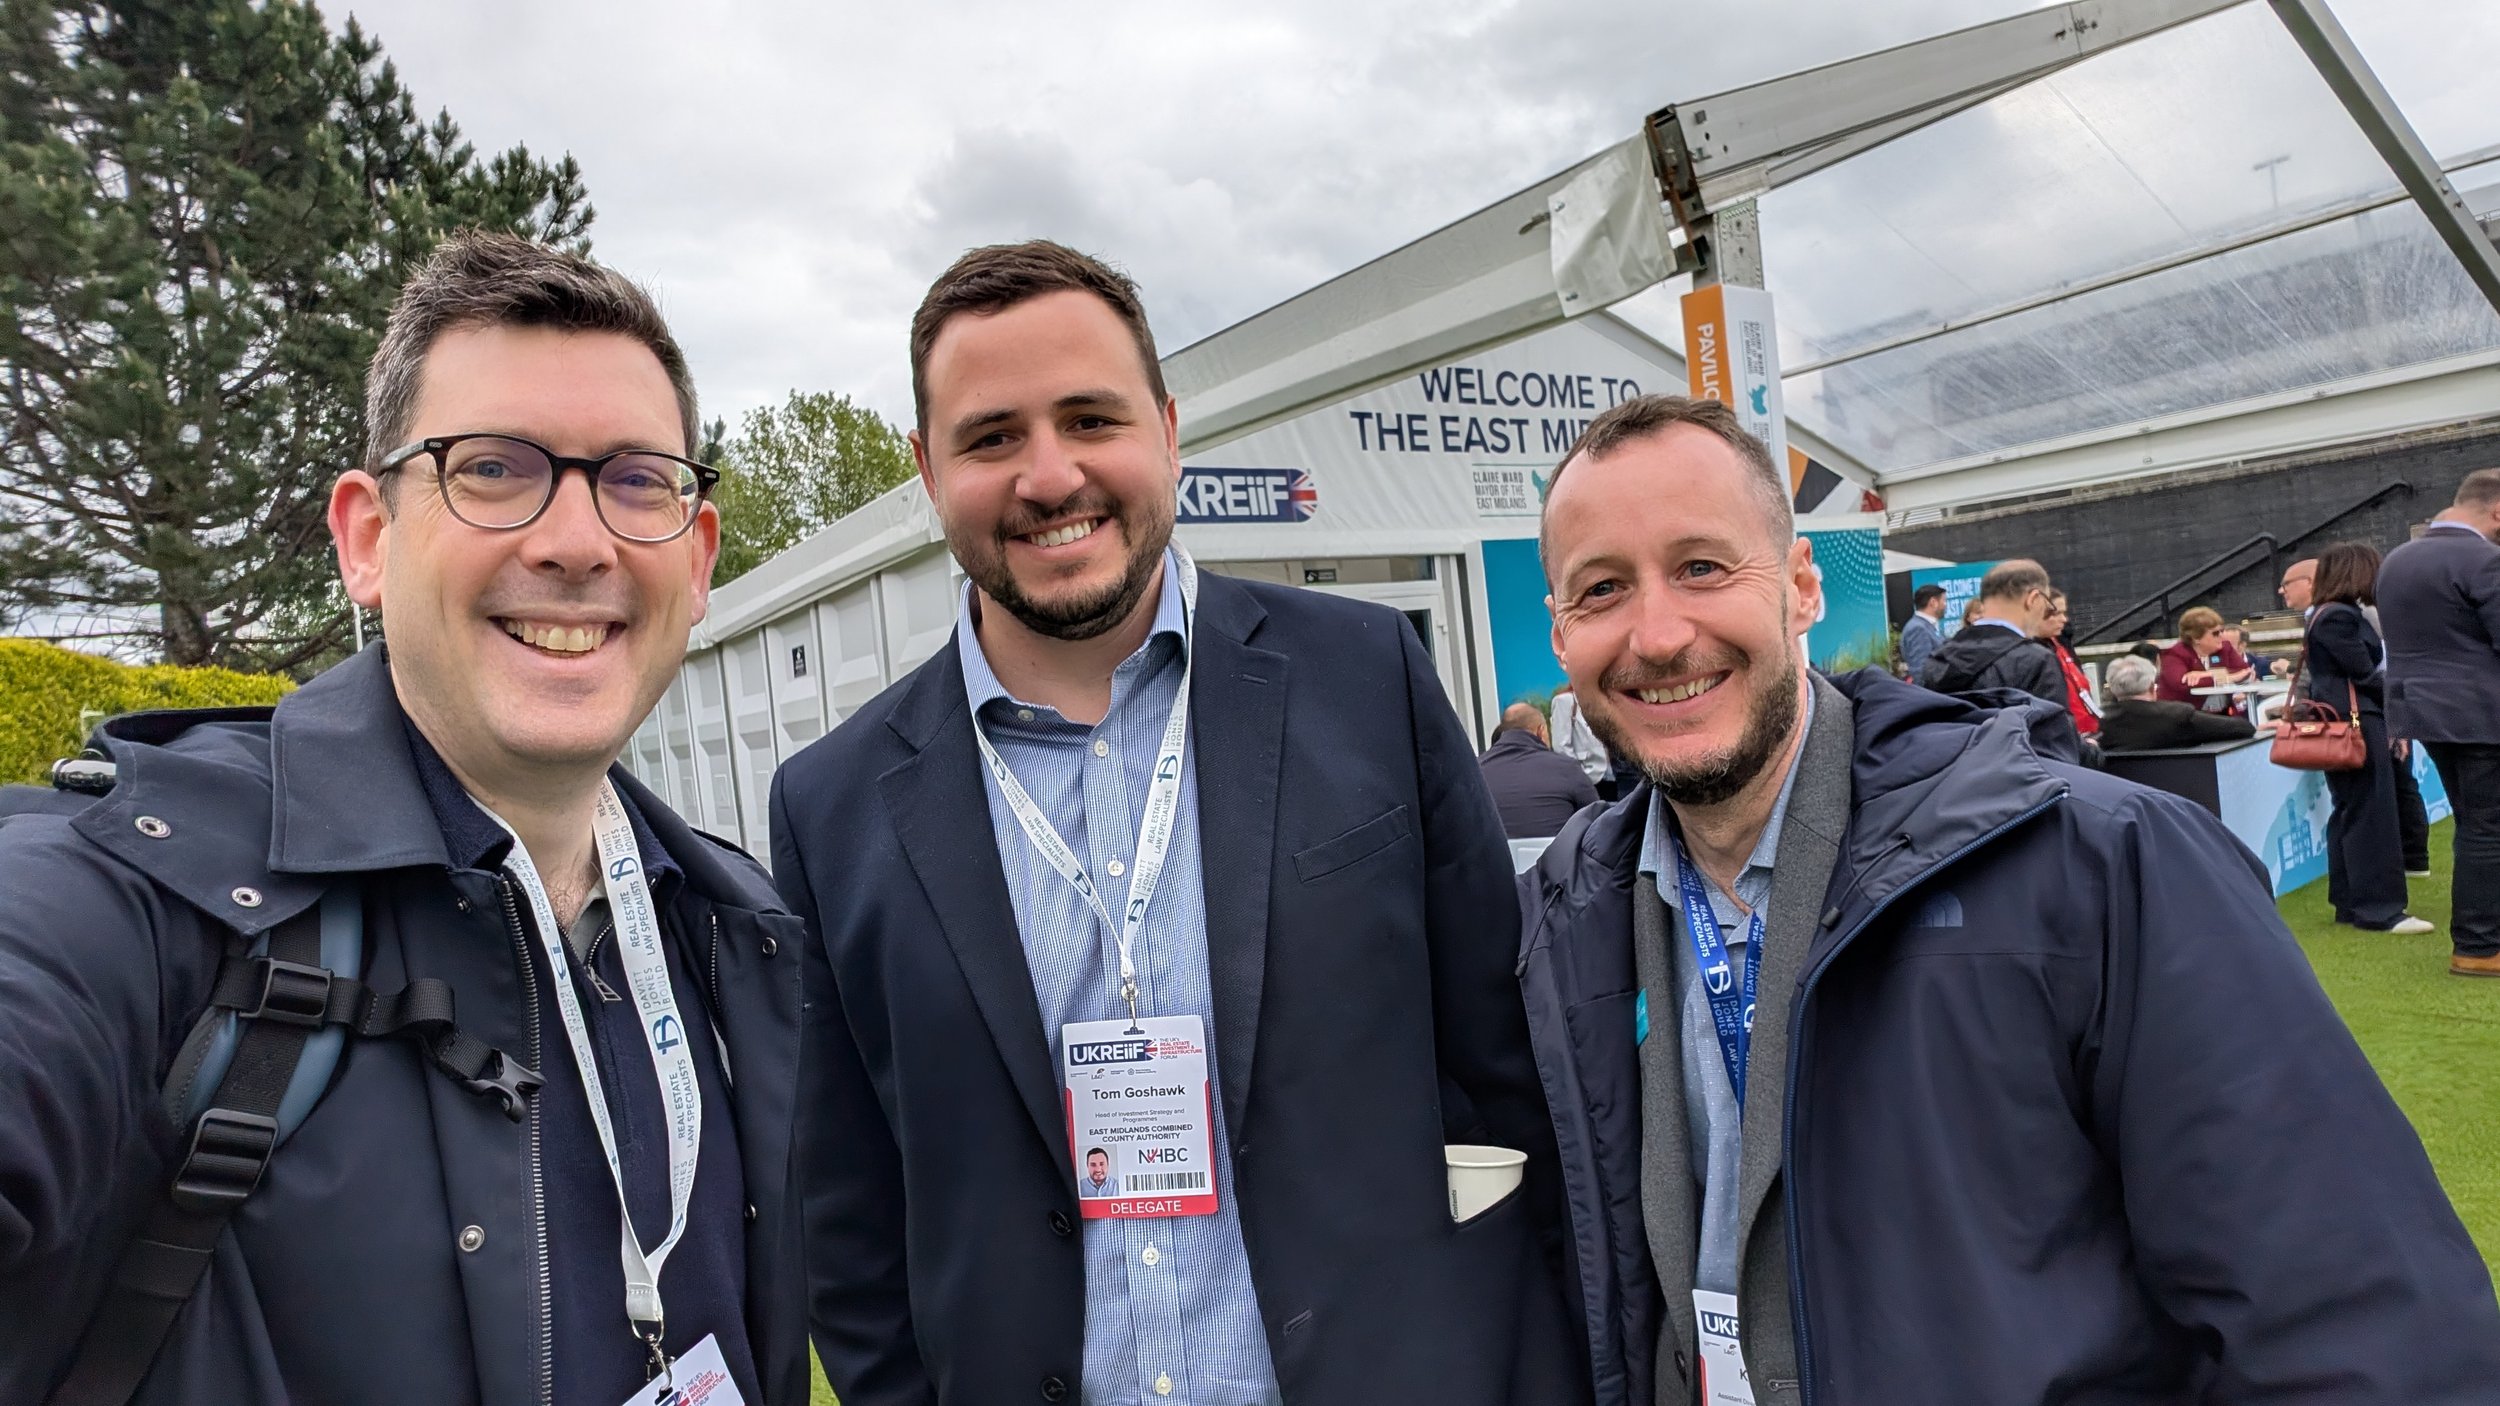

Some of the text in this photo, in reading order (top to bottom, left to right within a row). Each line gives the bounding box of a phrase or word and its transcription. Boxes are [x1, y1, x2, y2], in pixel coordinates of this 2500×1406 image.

[1420, 367, 1596, 409] WELCOME
[1350, 411, 1430, 452] THE
[1440, 415, 1530, 454] EAST
[1473, 471, 1524, 483] CLAIRE WARD
[1475, 484, 1524, 496] MAYOR OF THE
[1477, 497, 1493, 509] EAST
[1176, 715, 1184, 747] BOULD
[607, 804, 620, 820] LAW
[1005, 789, 1022, 813] BOULD
[1008, 785, 1025, 809] JONES
[1034, 817, 1065, 855] REAL ESTATE
[1147, 797, 1163, 844] REAL ESTATE
[1155, 790, 1172, 854] LAW SPECIALISTS
[602, 833, 614, 857] DAVITT
[611, 829, 625, 852] JONES
[1025, 815, 1067, 869] LAW SPECIALISTS
[521, 859, 551, 921] REAL ESTATE
[1135, 859, 1146, 889] DAVITT
[1141, 860, 1154, 891] JONES
[1147, 863, 1160, 892] BOULD
[507, 857, 551, 933] AW SPECIALISTS
[620, 891, 641, 948] REAL ESTATE
[630, 880, 656, 956] LAW SPECIALISTS
[1689, 895, 1711, 958] LAW SPECIALISTS
[1699, 904, 1718, 948] REAL ESTATE
[1752, 921, 1761, 942] REAL
[633, 970, 651, 1010] DAVITT
[643, 967, 660, 1006] JONES
[655, 964, 671, 1004] BOULD
[1746, 958, 1755, 993] DAVITT
[1712, 1003, 1728, 1037] BOULD
[1722, 1002, 1737, 1035] JONES
[1073, 1043, 1144, 1062] UKREiiF
[1727, 1043, 1739, 1063] LAW
[578, 1045, 608, 1138] LAW SPECIALISTS
[669, 1073, 685, 1139] REAL ESTATE
[677, 1058, 695, 1148] LAW SPECIALISTS
[1092, 1085, 1185, 1100] Tom Goshawk
[1110, 1126, 1150, 1134] MIDLANDS
[1151, 1124, 1193, 1132] COMBINED
[1136, 1133, 1181, 1141] AUTHORITY
[1111, 1200, 1182, 1214] DELEGATE
